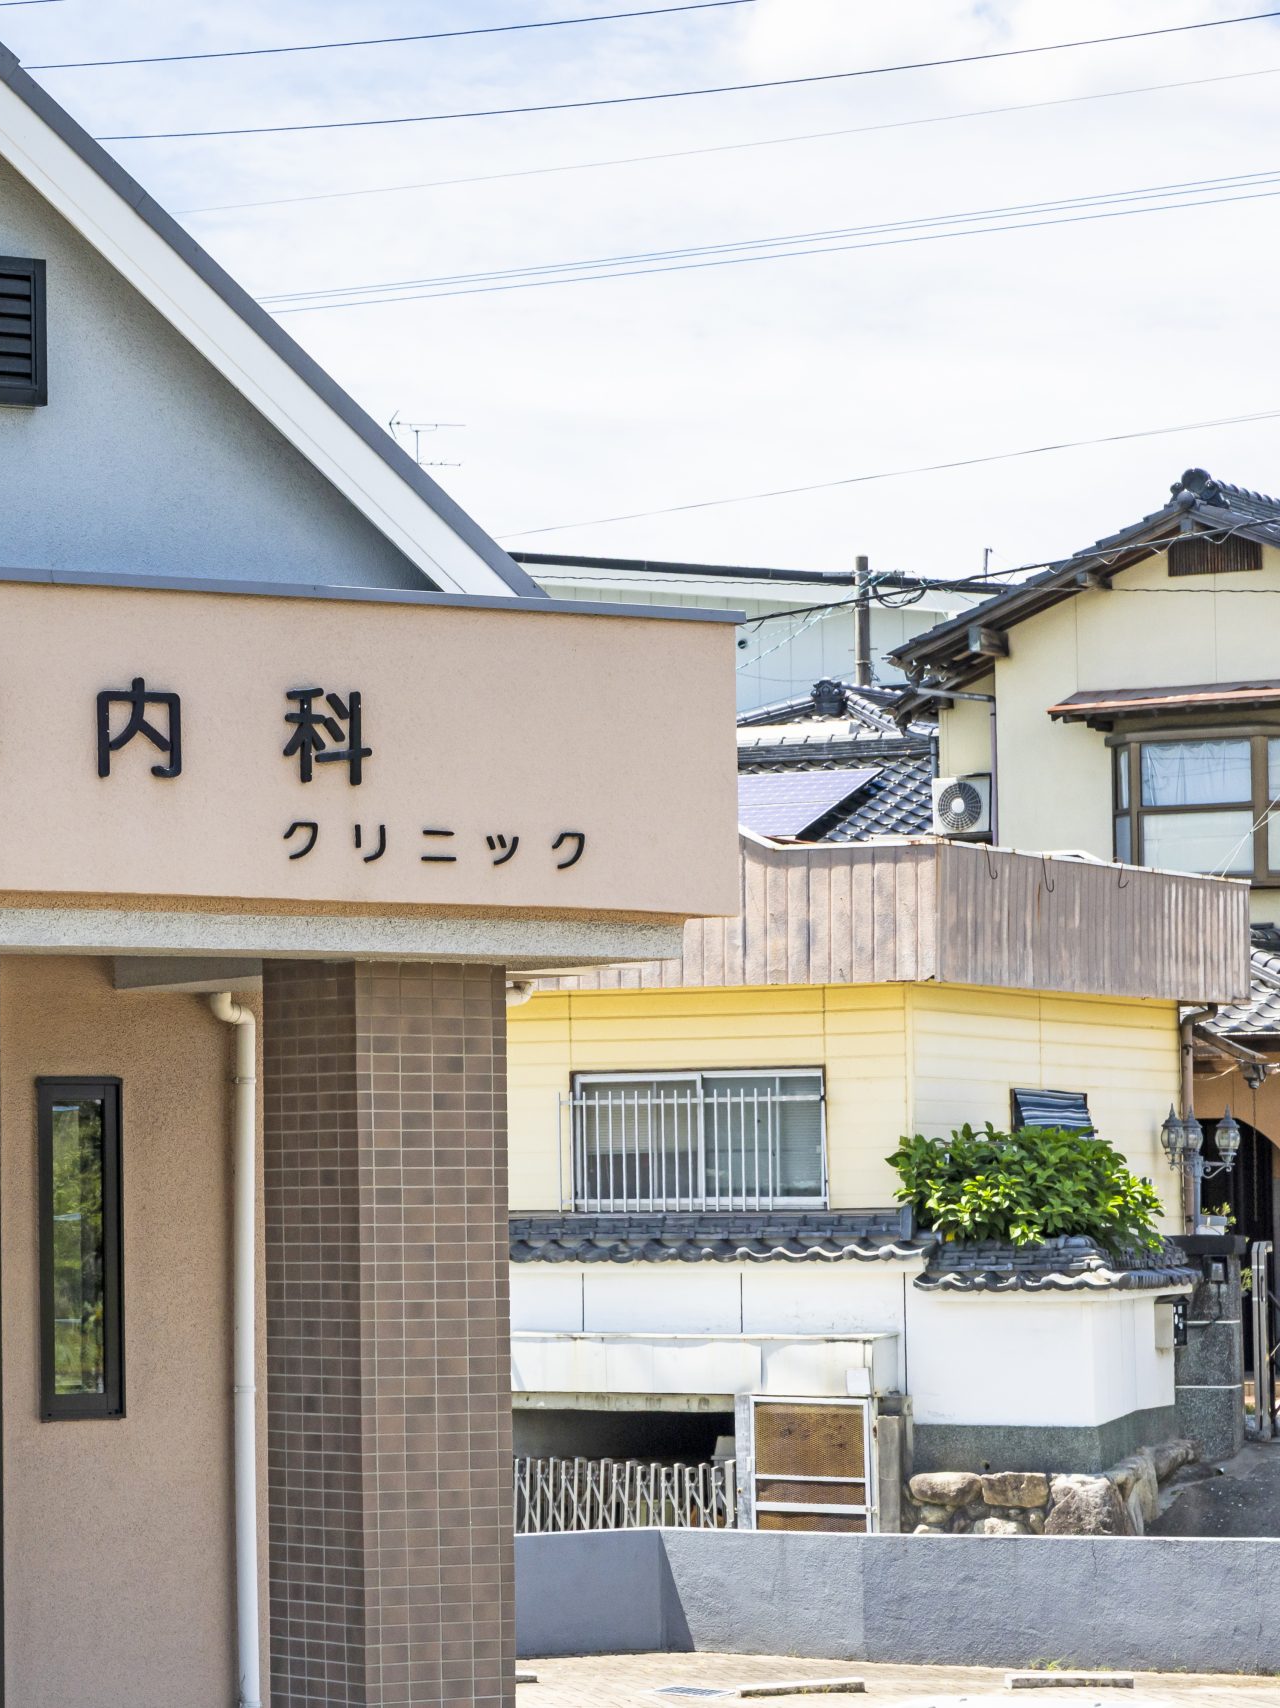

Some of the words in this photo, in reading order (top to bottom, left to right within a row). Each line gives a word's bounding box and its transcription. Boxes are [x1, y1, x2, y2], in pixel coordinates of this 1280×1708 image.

[283, 820, 587, 870] クリニック
